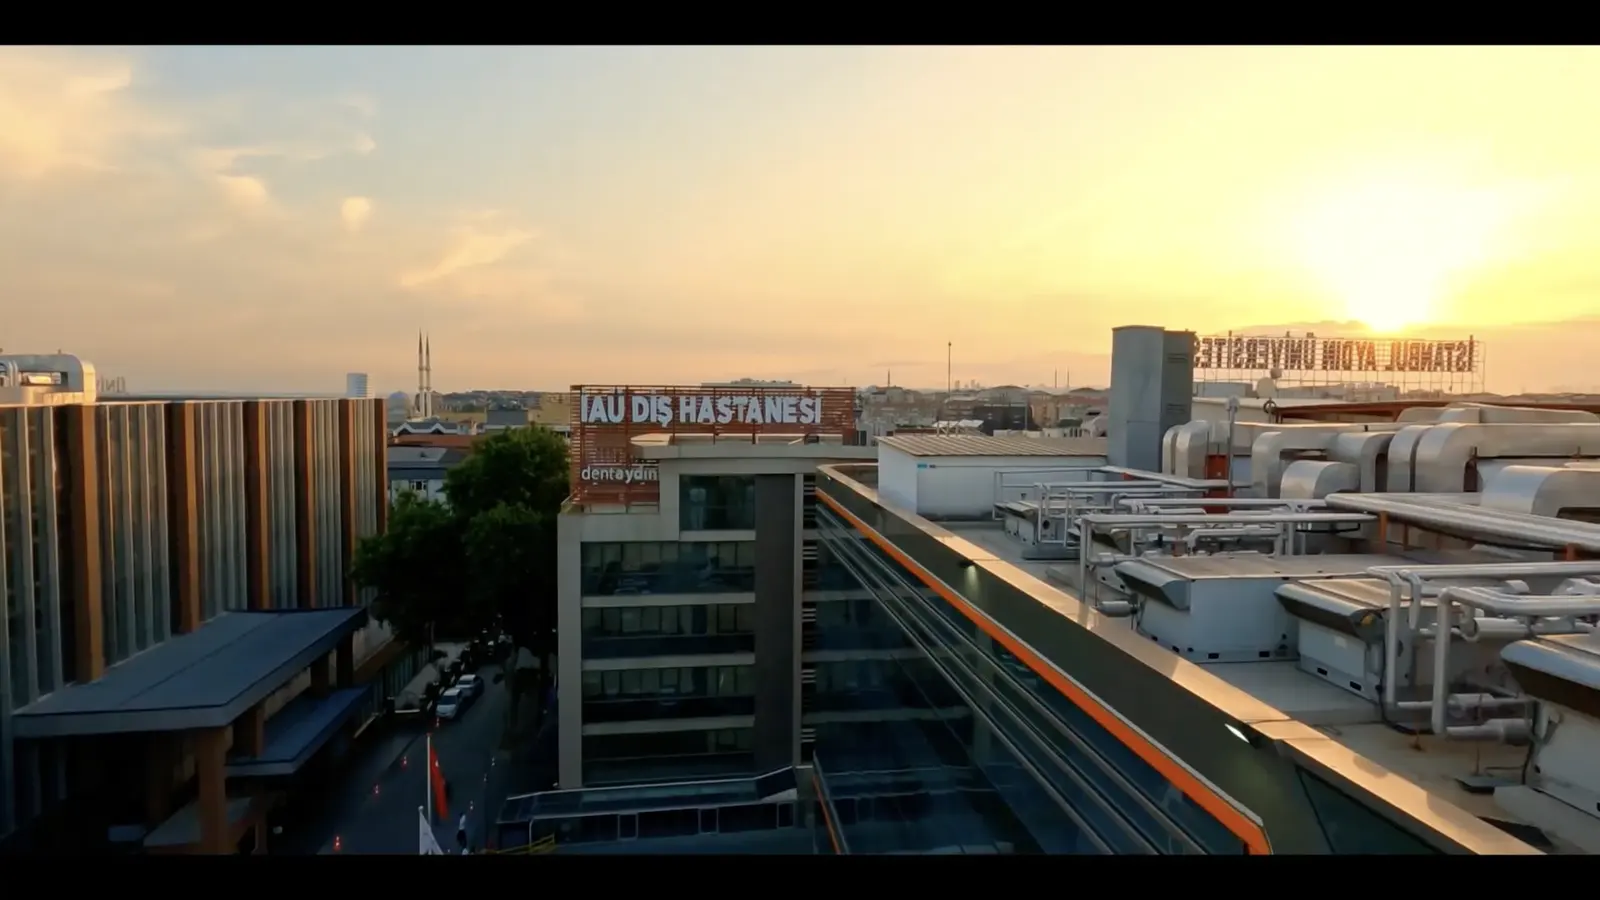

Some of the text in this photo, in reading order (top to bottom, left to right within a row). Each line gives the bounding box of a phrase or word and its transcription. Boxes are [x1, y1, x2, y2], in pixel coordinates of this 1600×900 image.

[580, 387, 822, 428] İAÜ DİŞ HASTANESİ
